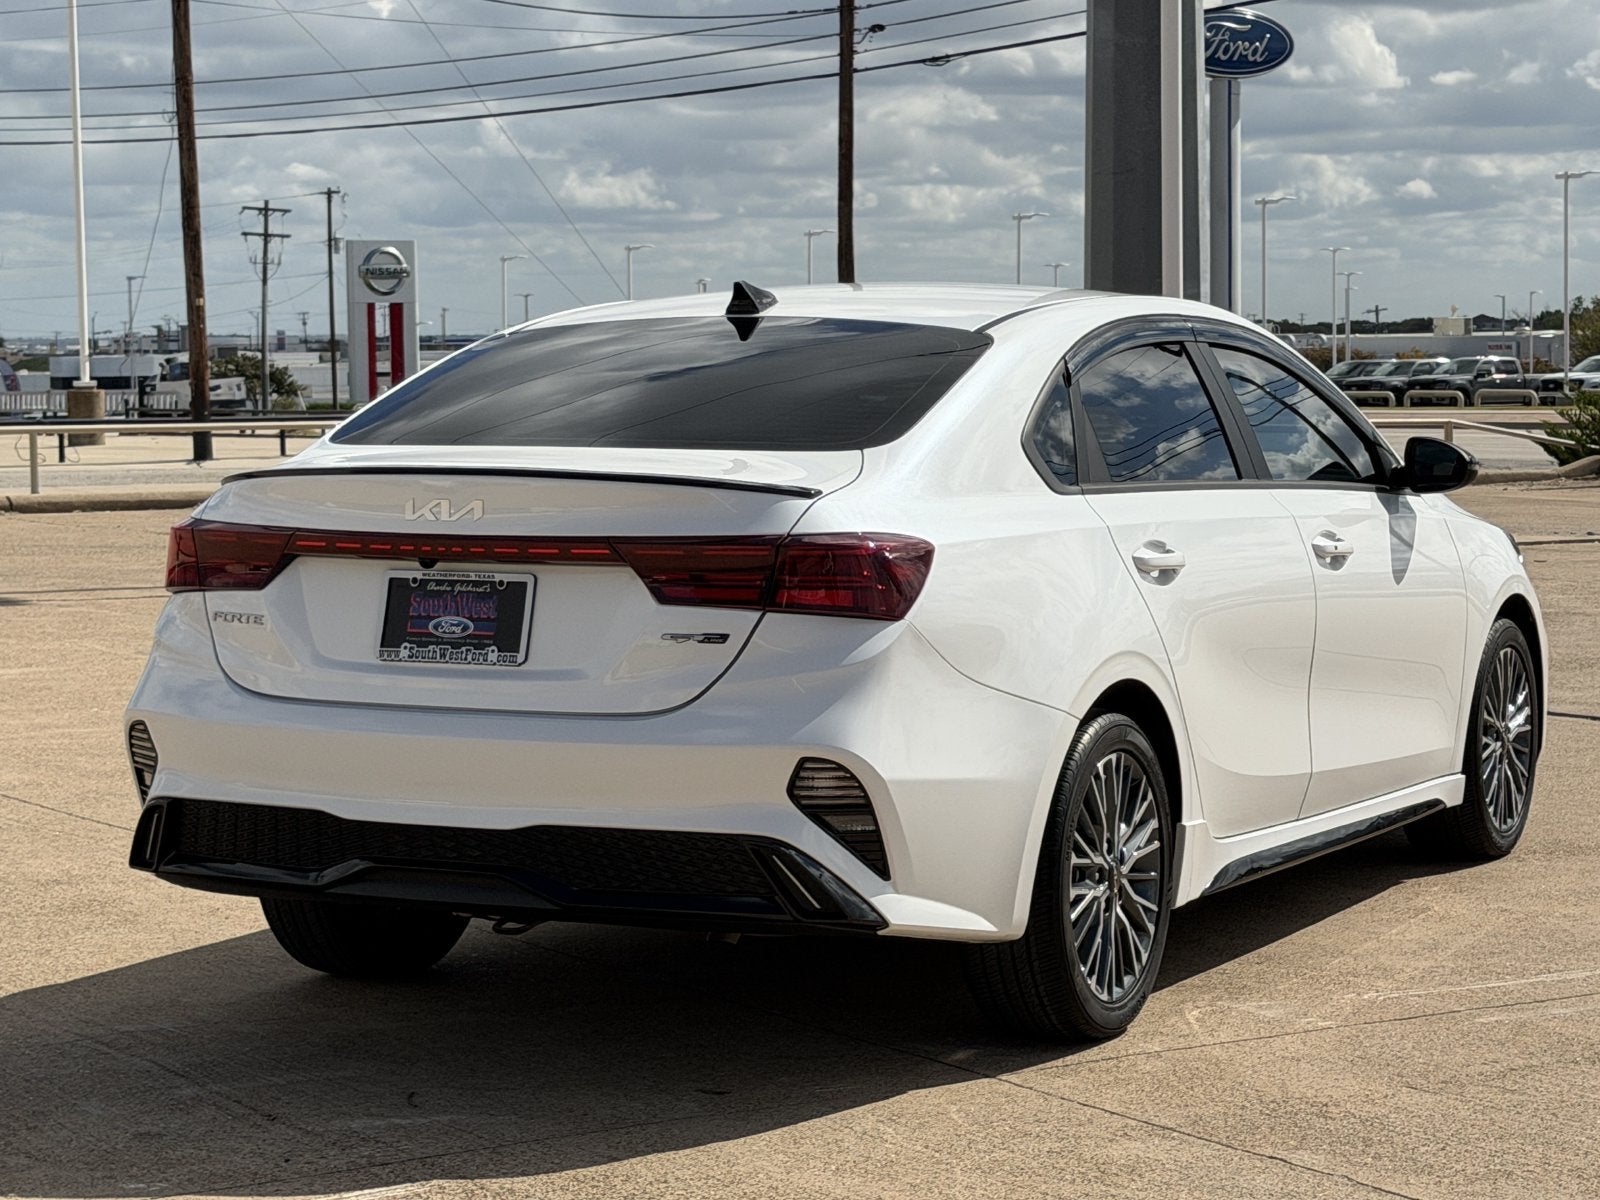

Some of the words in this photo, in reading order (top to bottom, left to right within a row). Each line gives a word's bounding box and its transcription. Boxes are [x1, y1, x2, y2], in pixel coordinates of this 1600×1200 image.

[1205, 21, 1271, 62] Ford
[365, 267, 408, 276] NISSAN
[405, 498, 484, 522] KIA
[213, 611, 265, 625] FORTE
[438, 620, 463, 633] Ford
